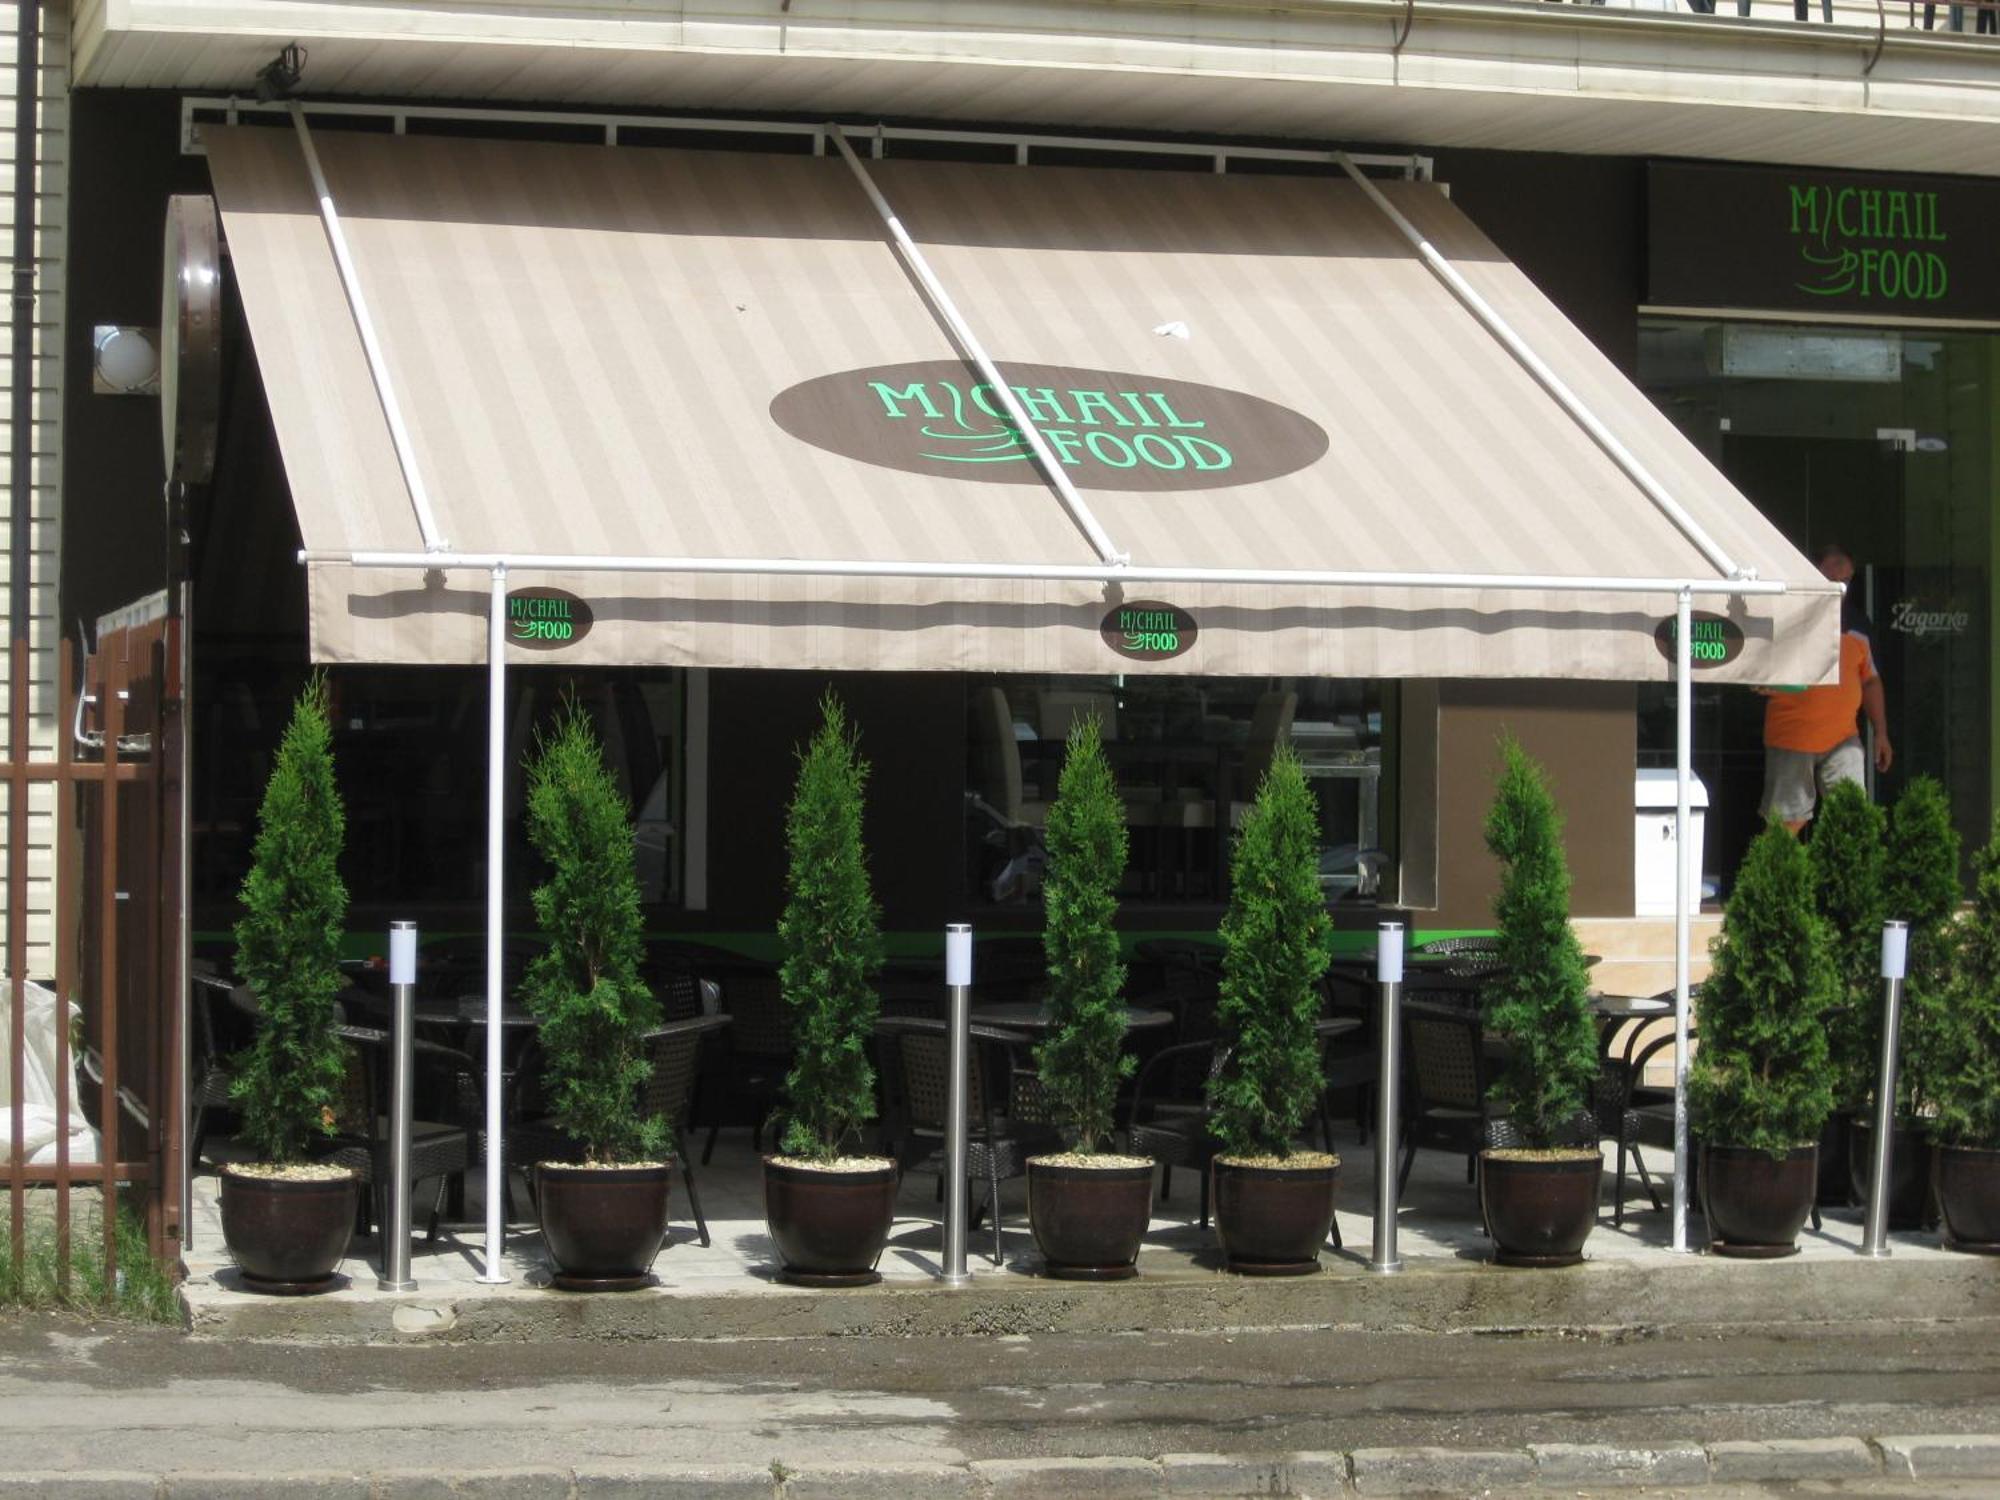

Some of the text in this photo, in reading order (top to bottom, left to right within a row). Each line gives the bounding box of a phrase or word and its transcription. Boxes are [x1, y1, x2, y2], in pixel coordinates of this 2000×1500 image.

[1788, 185, 1947, 243] MICHAIL
[1860, 249, 1947, 299] FOOD
[1040, 428, 1233, 471] FOOD
[511, 598, 571, 618] MICHAIL
[536, 620, 572, 640] FOOD
[1120, 609, 1177, 631] MICHAIL
[1144, 632, 1178, 651] FOOD
[1694, 642, 1726, 660] FOOD
